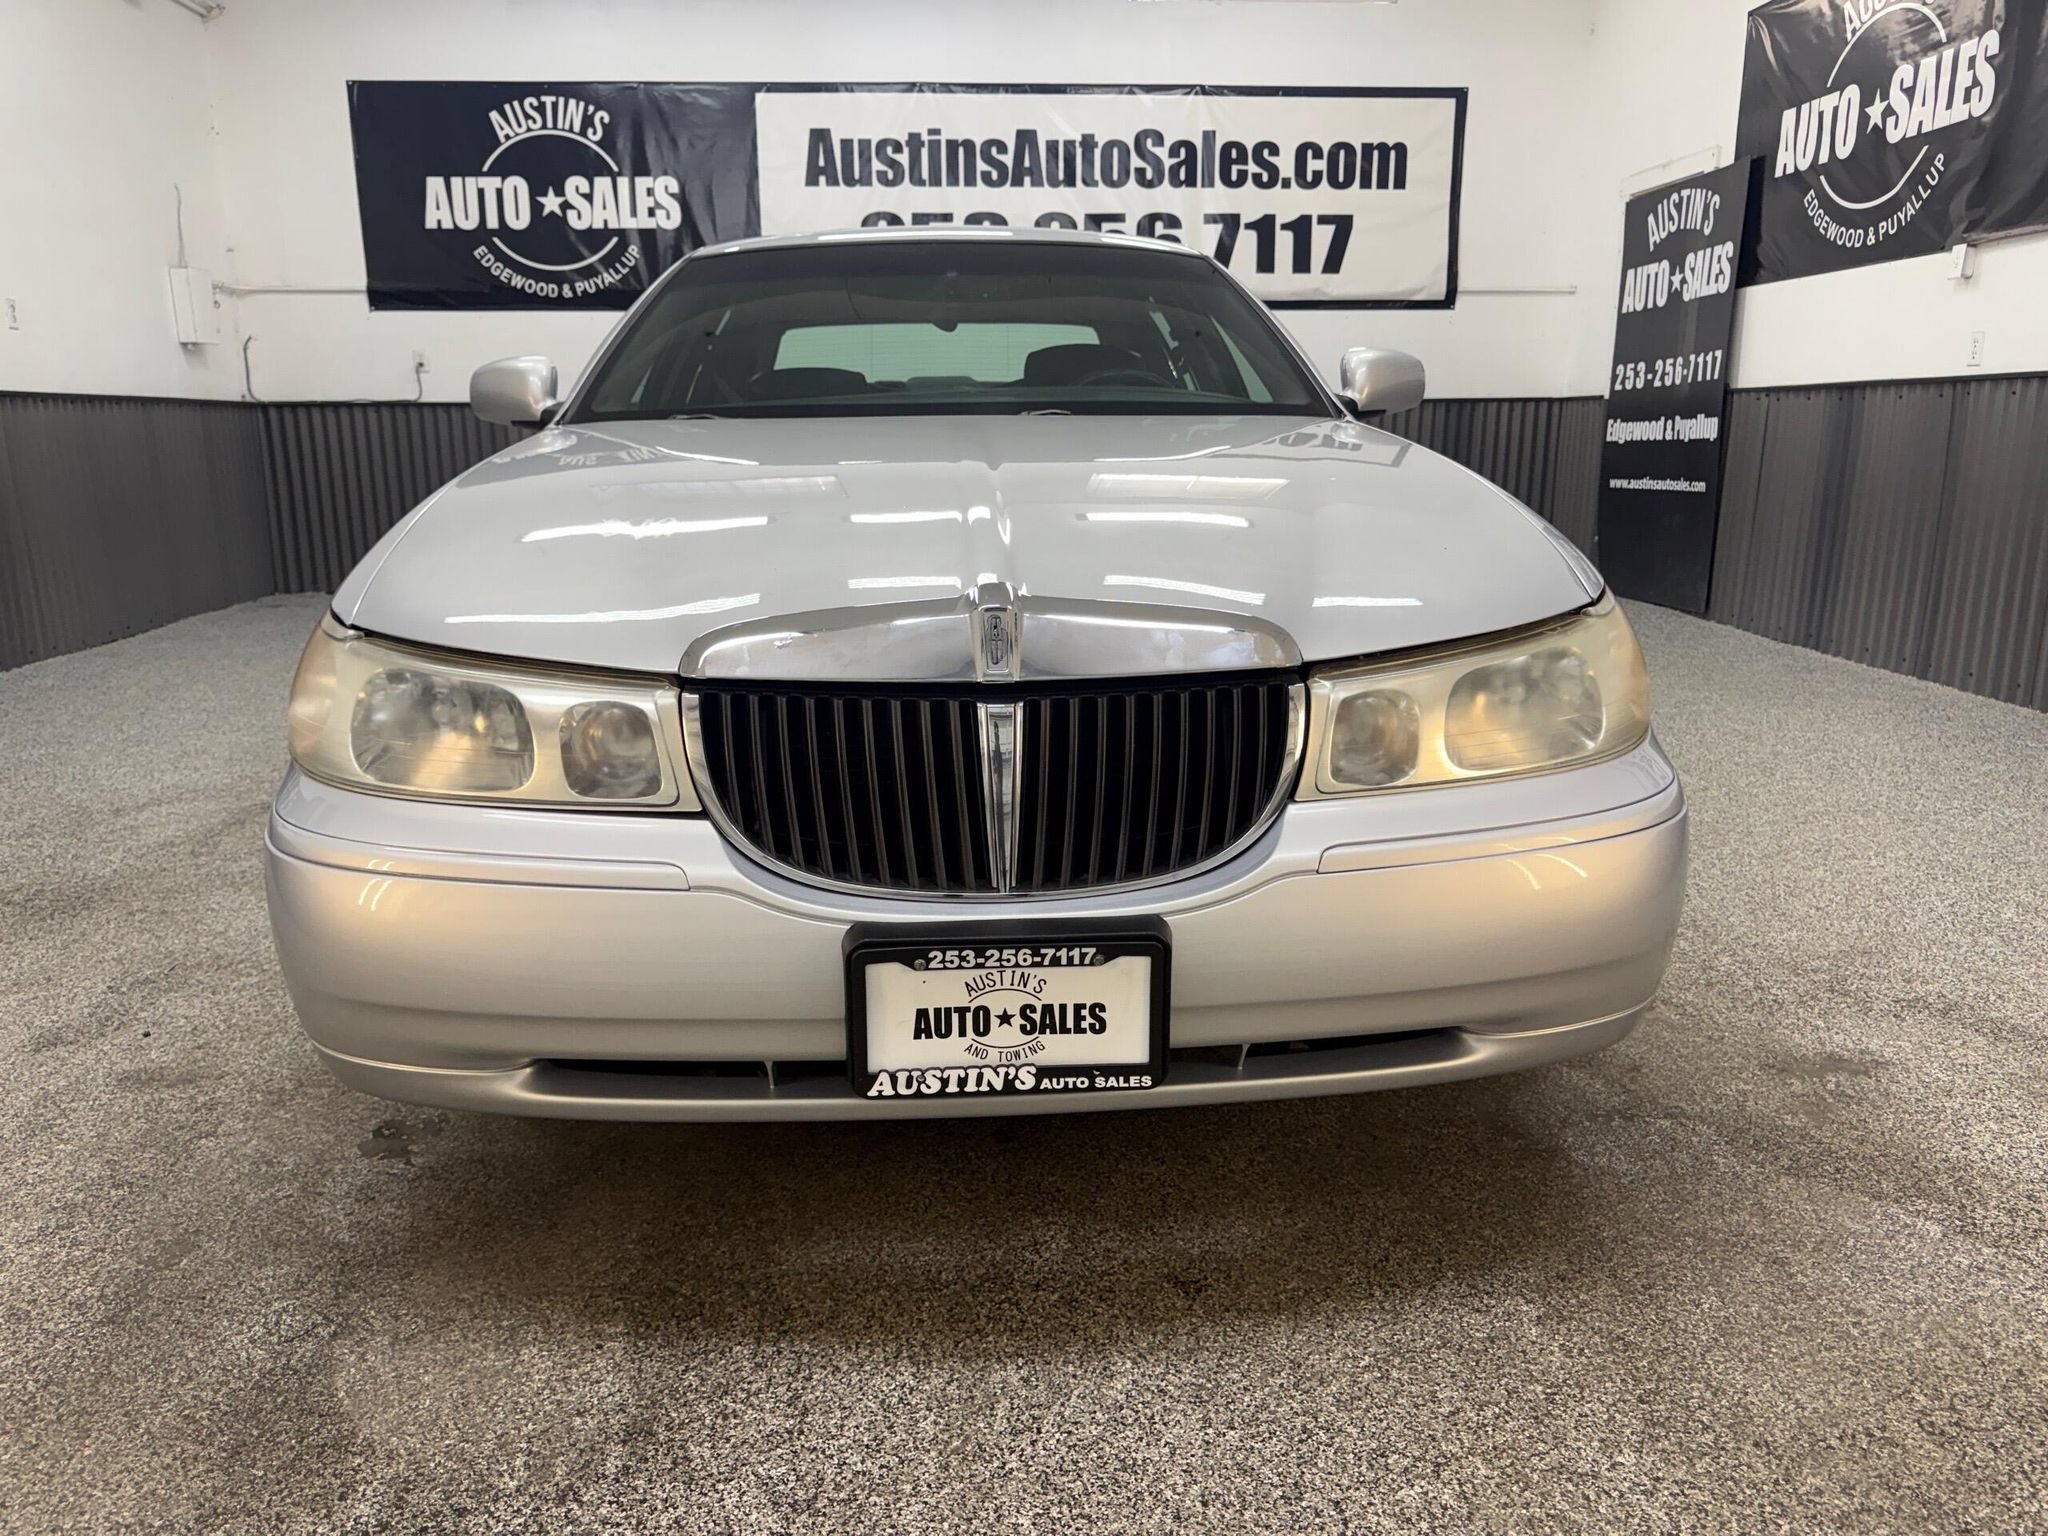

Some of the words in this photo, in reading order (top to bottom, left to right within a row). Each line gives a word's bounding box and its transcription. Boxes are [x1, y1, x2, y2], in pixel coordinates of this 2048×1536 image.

[488, 95, 610, 143] AUSTIN'S
[1774, 84, 1861, 179] AUTO
[1885, 29, 2000, 144] SALES
[804, 128, 1408, 191] AustinsAutoSales.com
[425, 176, 531, 231] AUTO
[564, 176, 682, 231] SALES
[1647, 188, 1721, 252] AUSTIN'S
[1804, 189, 1864, 248] EDGEWOOD
[1866, 227, 1876, 246] &
[1879, 153, 1946, 241] PUYALLUP
[473, 244, 559, 299] EDGEWOOD
[562, 284, 574, 299] &
[575, 243, 642, 298] PUYALLUP
[1621, 259, 1670, 314] AUTO
[1682, 241, 1734, 302] SALES
[1606, 416, 1665, 444] Edgewood
[1665, 419, 1673, 441] &
[1674, 413, 1719, 443] Puyallup
[1609, 476, 1706, 493] www.austinsautosales.com
[927, 947, 1097, 969] 253-256-7117
[964, 970, 1047, 998] AUSTIN'S
[912, 1004, 992, 1040] AUTO
[1019, 1002, 1107, 1036] SALES
[963, 1043, 989, 1061] AND
[998, 1040, 1046, 1063] TOWING
[867, 1064, 1037, 1097] AUSTIN'S
[1039, 1076, 1090, 1090] AUTO
[1094, 1075, 1153, 1088] SALES
